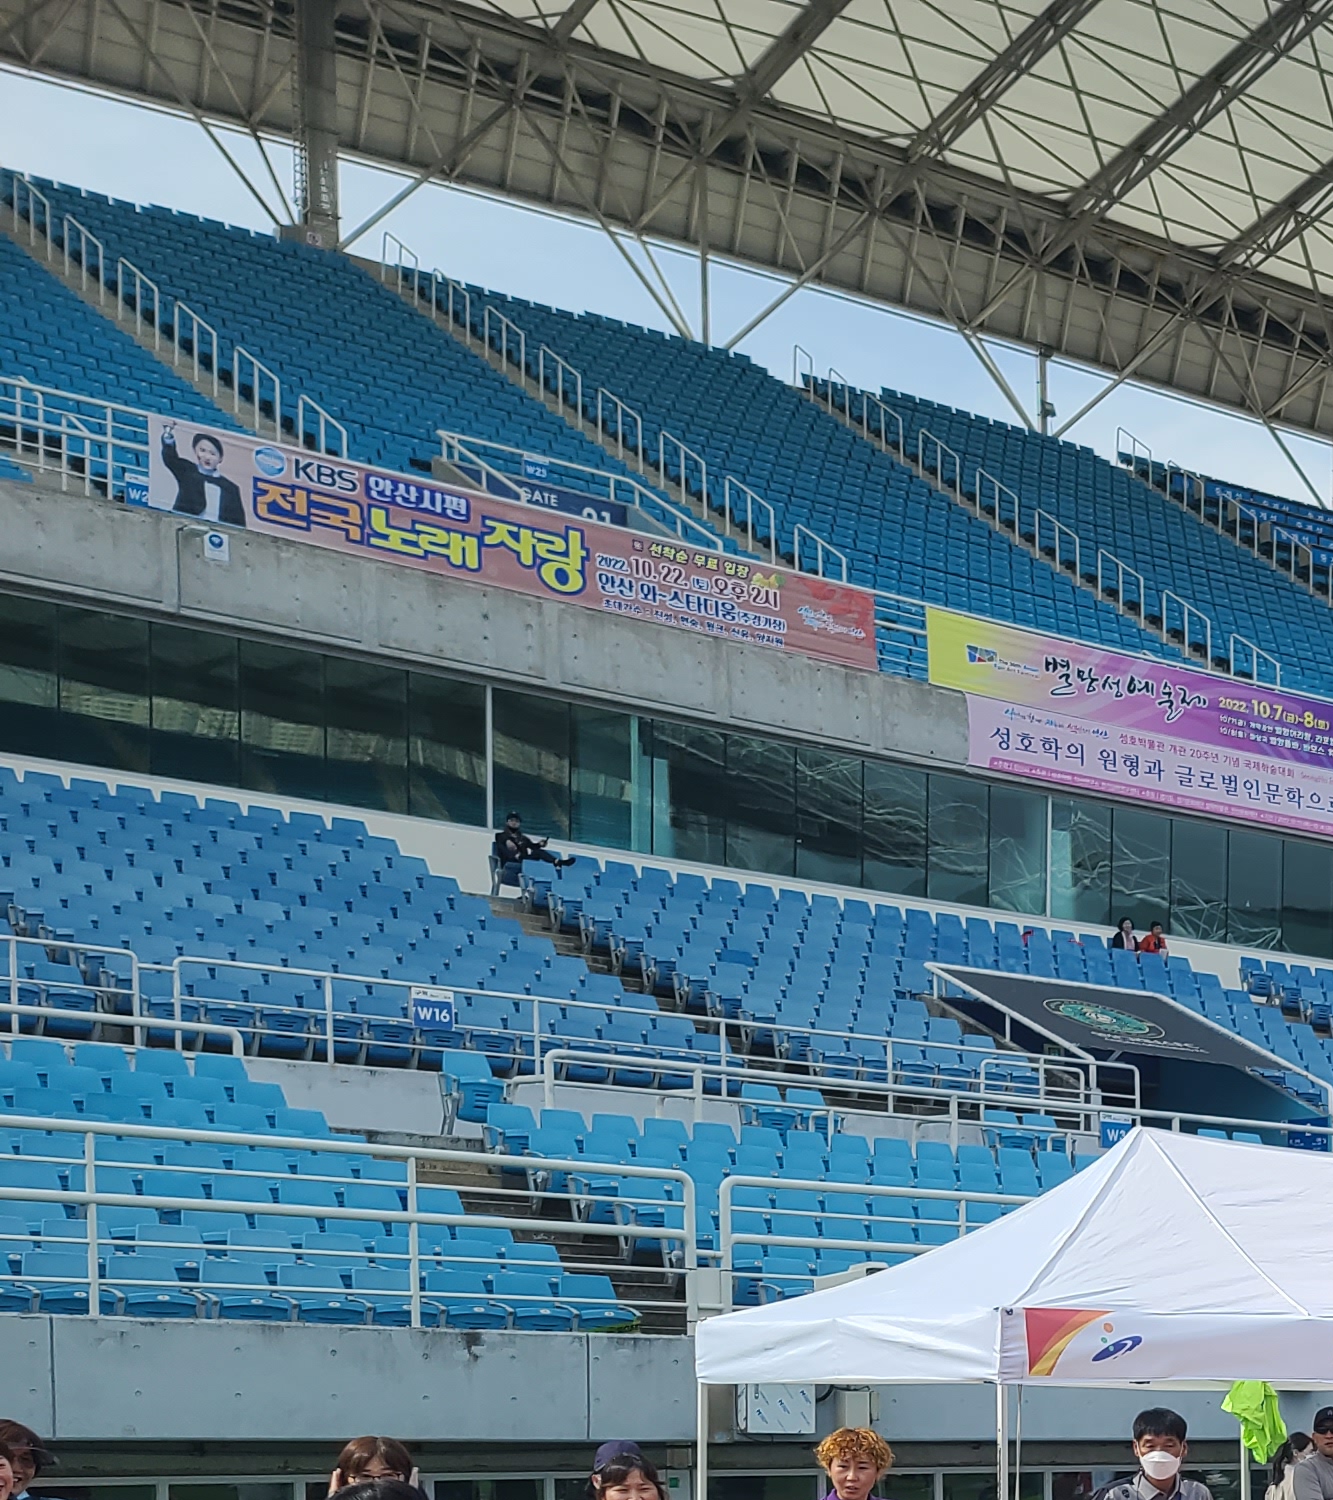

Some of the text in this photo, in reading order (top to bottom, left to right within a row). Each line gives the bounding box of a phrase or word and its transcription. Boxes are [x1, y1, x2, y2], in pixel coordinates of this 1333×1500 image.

[294, 456, 468, 521] KBS 안산시편
[650, 544, 689, 565] 선착순
[693, 553, 720, 570] 무료
[597, 572, 635, 598] 안산
[713, 577, 748, 601] 오후
[750, 586, 780, 610] 2시
[1218, 697, 1250, 714] 2022.
[989, 726, 1085, 766] 성호학의
[1098, 749, 1165, 782] 원형과
[417, 1006, 450, 1024] W16
